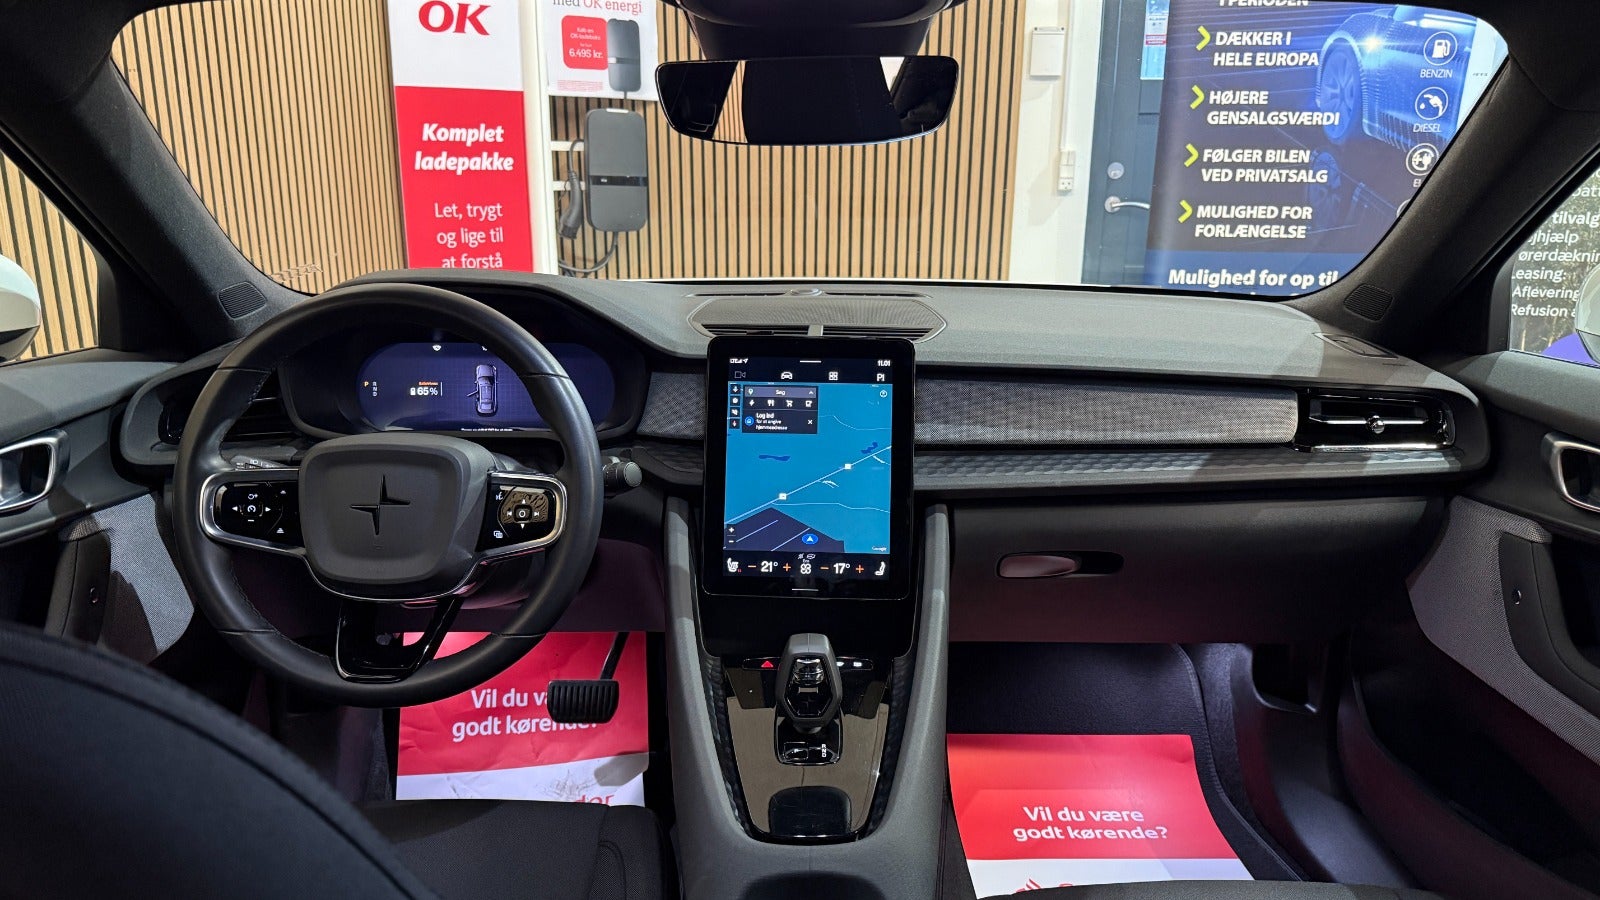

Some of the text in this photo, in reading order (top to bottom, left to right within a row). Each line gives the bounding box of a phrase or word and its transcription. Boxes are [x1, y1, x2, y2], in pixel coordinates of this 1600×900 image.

[605, 0, 642, 15] energi
[418, 0, 491, 36] OK
[1215, 31, 1292, 46] DÆKKER I
[569, 48, 592, 58] 6.495
[1213, 52, 1319, 67] HELE EUROPA
[1420, 69, 1453, 79] BENZIN
[1209, 90, 1268, 106] HØJERE
[1207, 111, 1340, 127] GENSALGSVÆRDI
[422, 123, 504, 147] Komplet
[1413, 124, 1441, 133] DIESEL
[414, 151, 514, 175] ladepakke
[1202, 148, 1311, 164] FØLGER BILEN
[1201, 168, 1328, 184] VED PRIVATSALG
[434, 203, 503, 221] Let, trygt
[1196, 205, 1313, 220] MULIGHED FOR
[436, 227, 504, 248] og lige til
[1194, 224, 1307, 240] FORLÆNGELSE
[441, 251, 504, 269] at forstå
[1168, 269, 1339, 290] Mulighed for op til
[1511, 304, 1568, 317] Refusion
[471, 689, 497, 709] Vil
[502, 688, 529, 708] du
[452, 715, 502, 743] godt
[1023, 806, 1144, 822] Vil du være
[1013, 826, 1168, 842] godt kørende?
